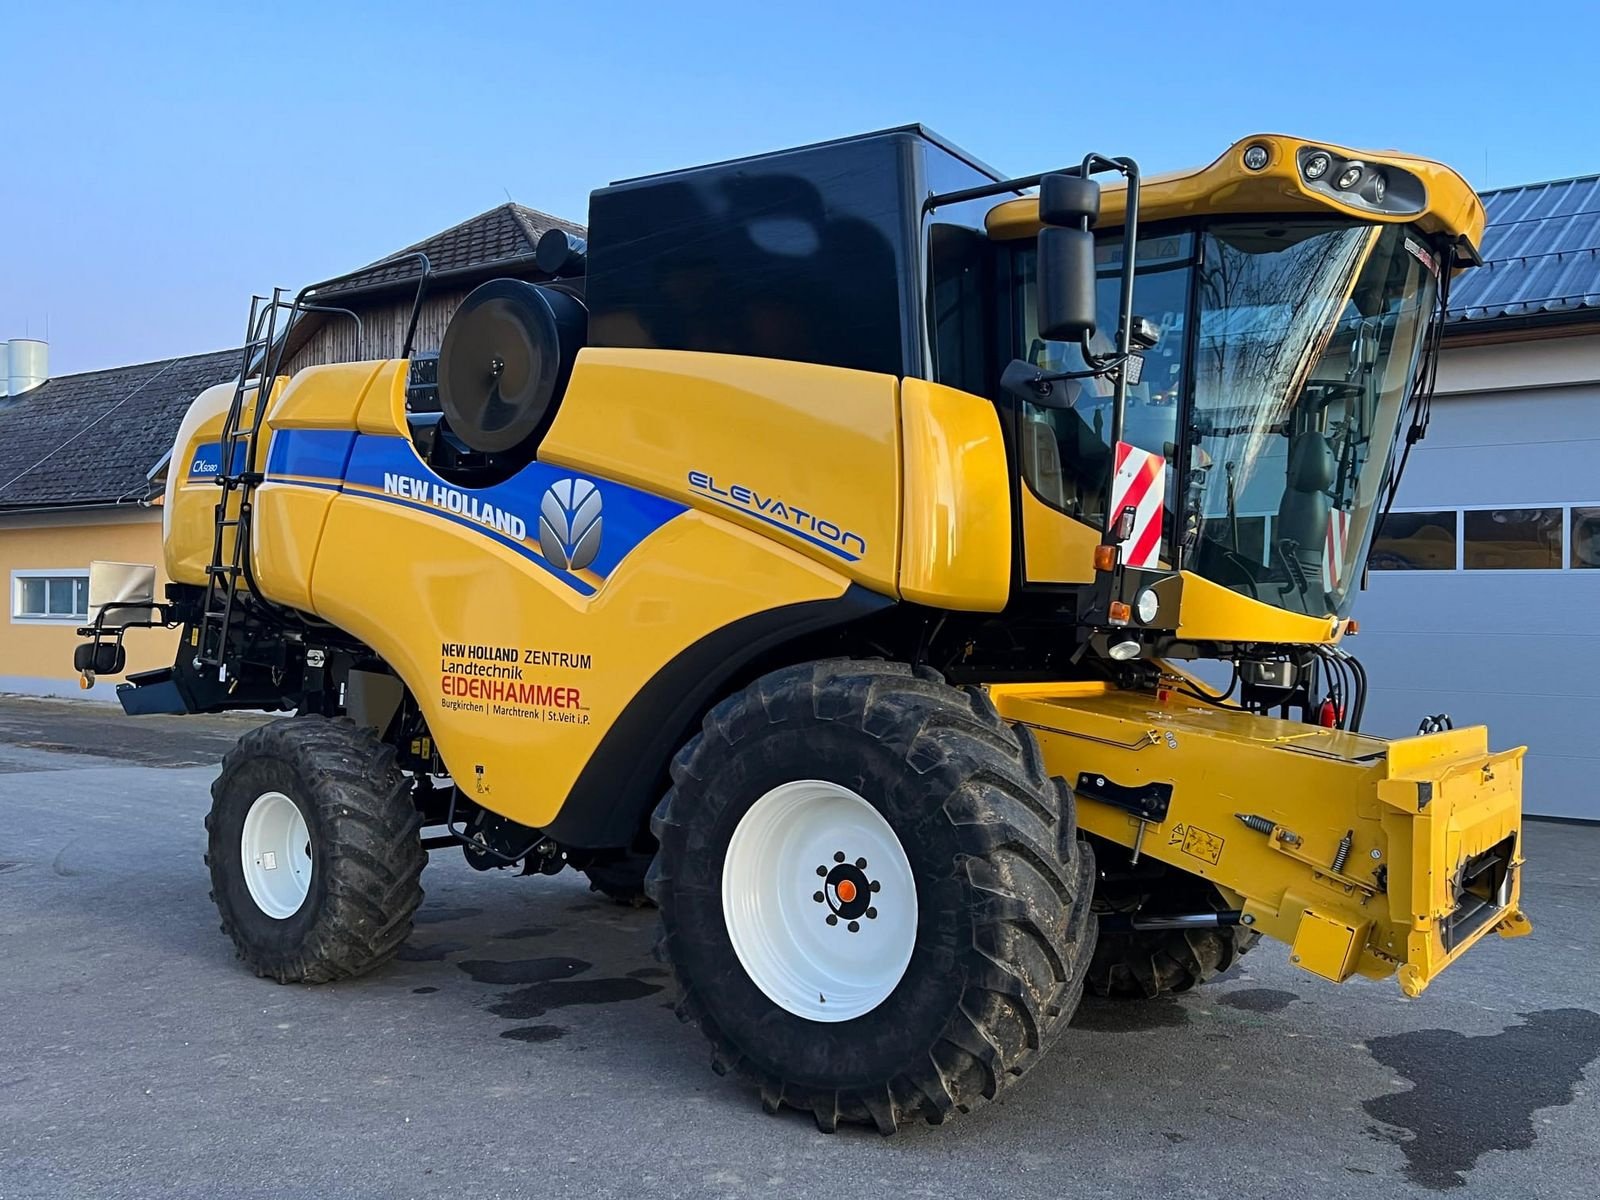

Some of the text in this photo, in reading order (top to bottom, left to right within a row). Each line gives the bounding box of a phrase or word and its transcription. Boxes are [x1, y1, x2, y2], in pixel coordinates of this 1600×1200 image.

[384, 472, 527, 541] NEW HOLLAND
[441, 659, 523, 680] Landtechnik
[442, 643, 591, 669] NEW HOLLAND ZENTRUM
[441, 675, 580, 710] EIDENHAMMER
[441, 698, 484, 713] Burgkirchen
[493, 705, 539, 719] Marchtrenk
[548, 711, 576, 724] St.Veit
[577, 713, 590, 725] i.P.
